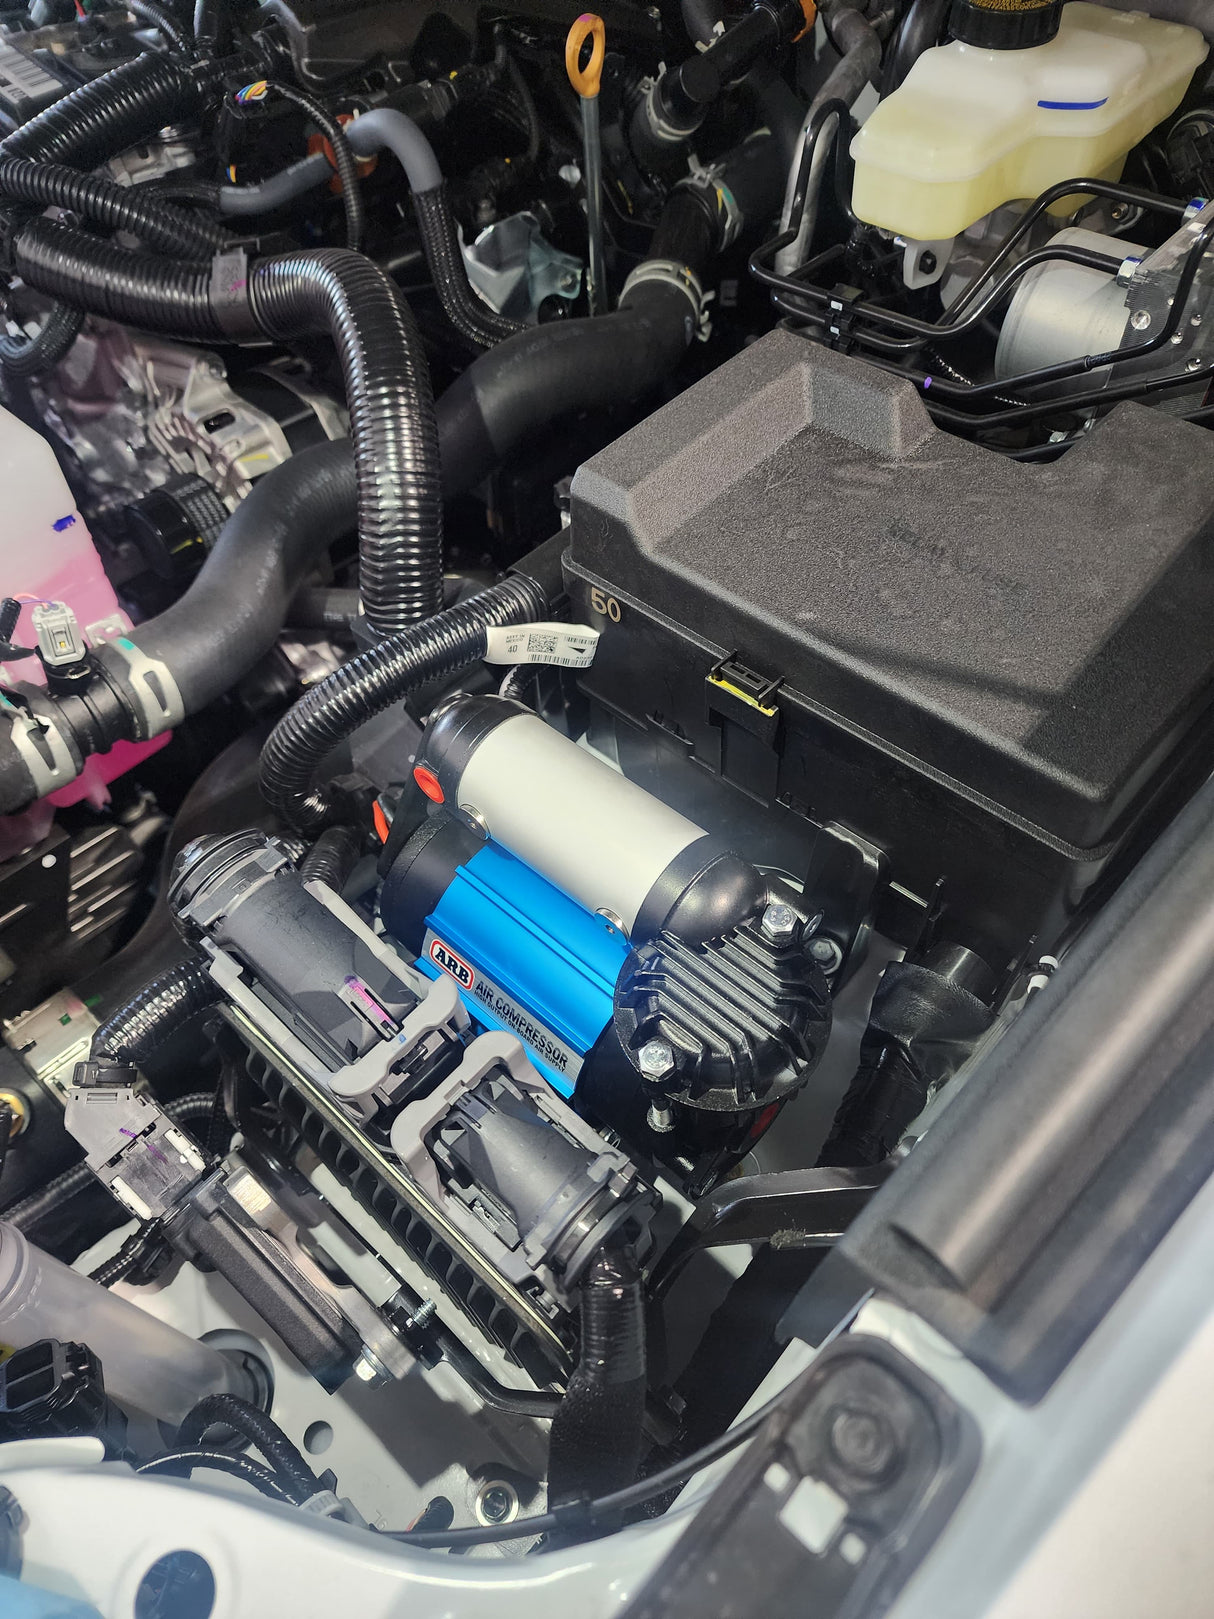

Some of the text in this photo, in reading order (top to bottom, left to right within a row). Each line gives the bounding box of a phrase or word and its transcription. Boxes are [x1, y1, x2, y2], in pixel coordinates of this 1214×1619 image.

[591, 586, 621, 623] 50
[508, 645, 518, 653] 40
[435, 948, 469, 984] ARB
[474, 990, 565, 1073] HIGH OUTPUT ON-BOARD AIR SUPPLY
[475, 981, 568, 1068] AIR COMPRESSOR
